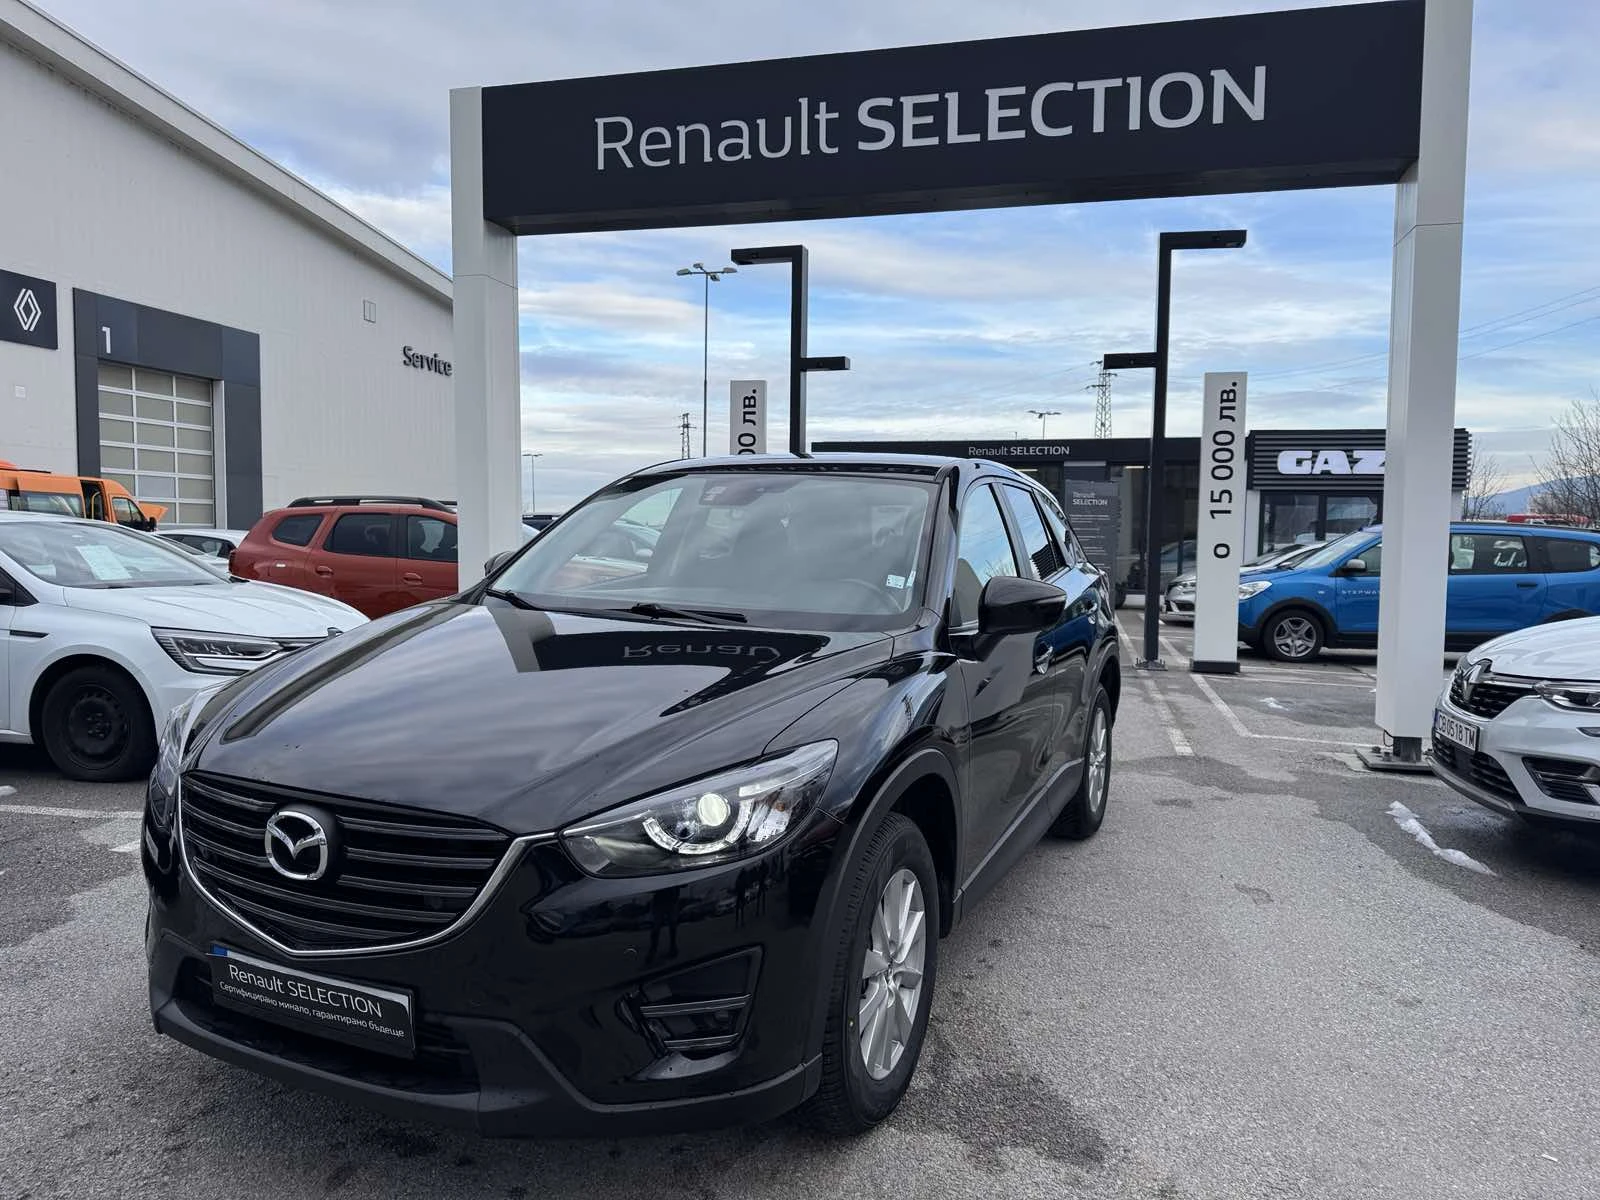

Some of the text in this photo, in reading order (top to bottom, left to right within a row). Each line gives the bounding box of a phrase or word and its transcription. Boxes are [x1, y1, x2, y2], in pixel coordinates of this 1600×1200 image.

[595, 65, 1267, 171] Renault SELECTION
[101, 325, 111, 354] 1
[403, 345, 453, 377] Service
[968, 446, 1070, 456] Renault SELECTION
[1211, 430, 1235, 480] 000
[1277, 450, 1386, 475] GAZ
[1072, 498, 1108, 506] SELECTION
[1209, 489, 1233, 519] 15
[228, 964, 383, 1018] Renault SELECTION
[219, 981, 278, 1007] Сертифицирано
[312, 1009, 368, 1028] гарантирано
[368, 1020, 405, 1038] бъдеще
